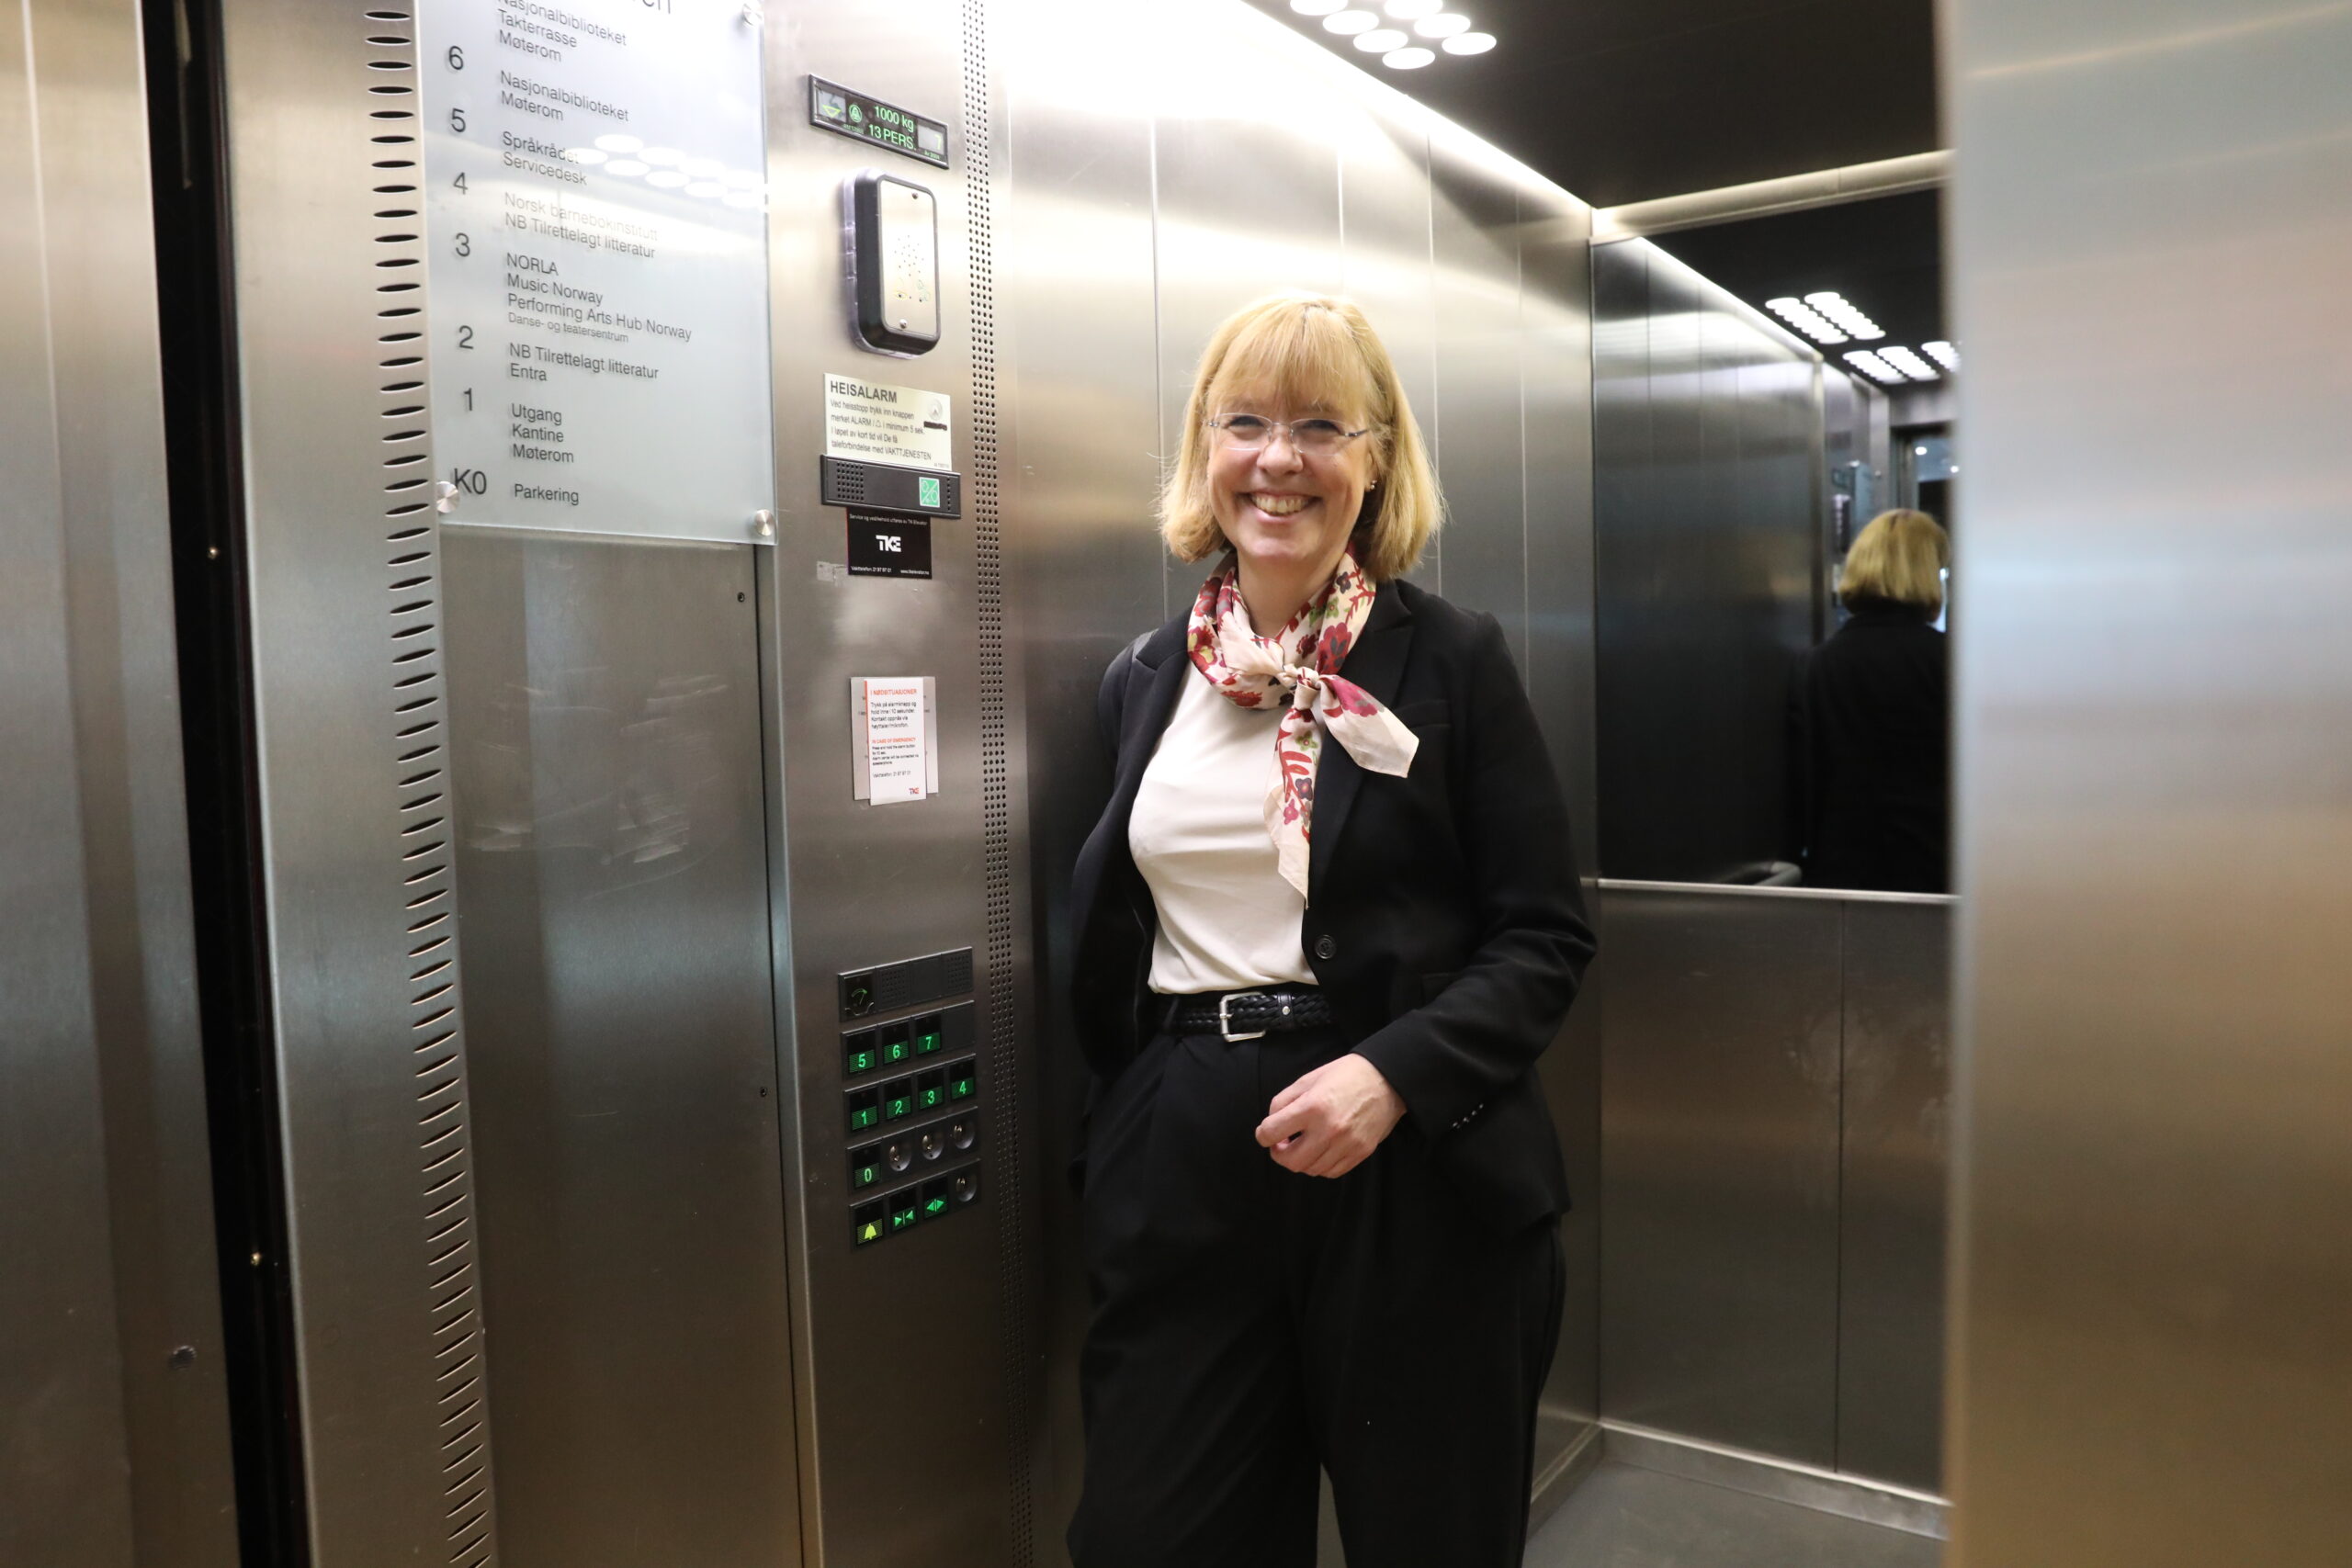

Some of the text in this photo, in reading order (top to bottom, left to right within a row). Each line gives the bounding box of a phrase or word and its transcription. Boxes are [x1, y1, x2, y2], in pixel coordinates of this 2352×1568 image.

[497, 9, 577, 48] Takterrasse
[499, 0, 628, 46] asjonalbiblioteket
[499, 29, 561, 62] Møterom
[448, 46, 464, 71] 6
[500, 70, 629, 121] Nasjonalbiblioteket
[501, 91, 563, 120] Møterom
[451, 108, 466, 132] 5
[874, 106, 914, 132] 1000 kg
[868, 124, 882, 139] 13
[883, 130, 917, 151] PERS.
[503, 152, 587, 185] Servicedesk
[453, 172, 469, 195] 4
[505, 192, 658, 241] Norsk barnebokinstitutt
[455, 233, 470, 257] 3
[505, 212, 655, 258] NB Tilrettelagt litteratur
[506, 253, 559, 276] NORLA
[507, 273, 603, 306] Music Norway
[508, 293, 692, 343] Performing Arts Hub Norway
[508, 312, 628, 343] Danse- og teatersentrum
[458, 325, 474, 349] 2
[510, 343, 659, 379] NB Tilrettelagt litteratur
[510, 363, 548, 381] Entra
[463, 388, 473, 412] 1
[831, 380, 898, 403] HEISALARM
[511, 403, 562, 425] Utgang
[831, 399, 842, 409] Ved
[892, 409, 915, 420] knappen
[512, 423, 564, 443] Kantine
[831, 414, 850, 423] merket
[851, 416, 872, 425] ALARM
[886, 422, 910, 432] minimum
[857, 430, 868, 439] kort
[883, 434, 891, 442] De
[513, 445, 574, 463] Møterom
[872, 445, 884, 454] med
[885, 447, 932, 460] VAKTTJENESTEN
[453, 468, 487, 496] K0
[514, 483, 579, 505] Parkering
[875, 535, 901, 552] TKE
[858, 1036, 933, 1068] 5 6 7
[861, 1081, 967, 1125] 1 2 3 4
[864, 1168, 872, 1182] 0
